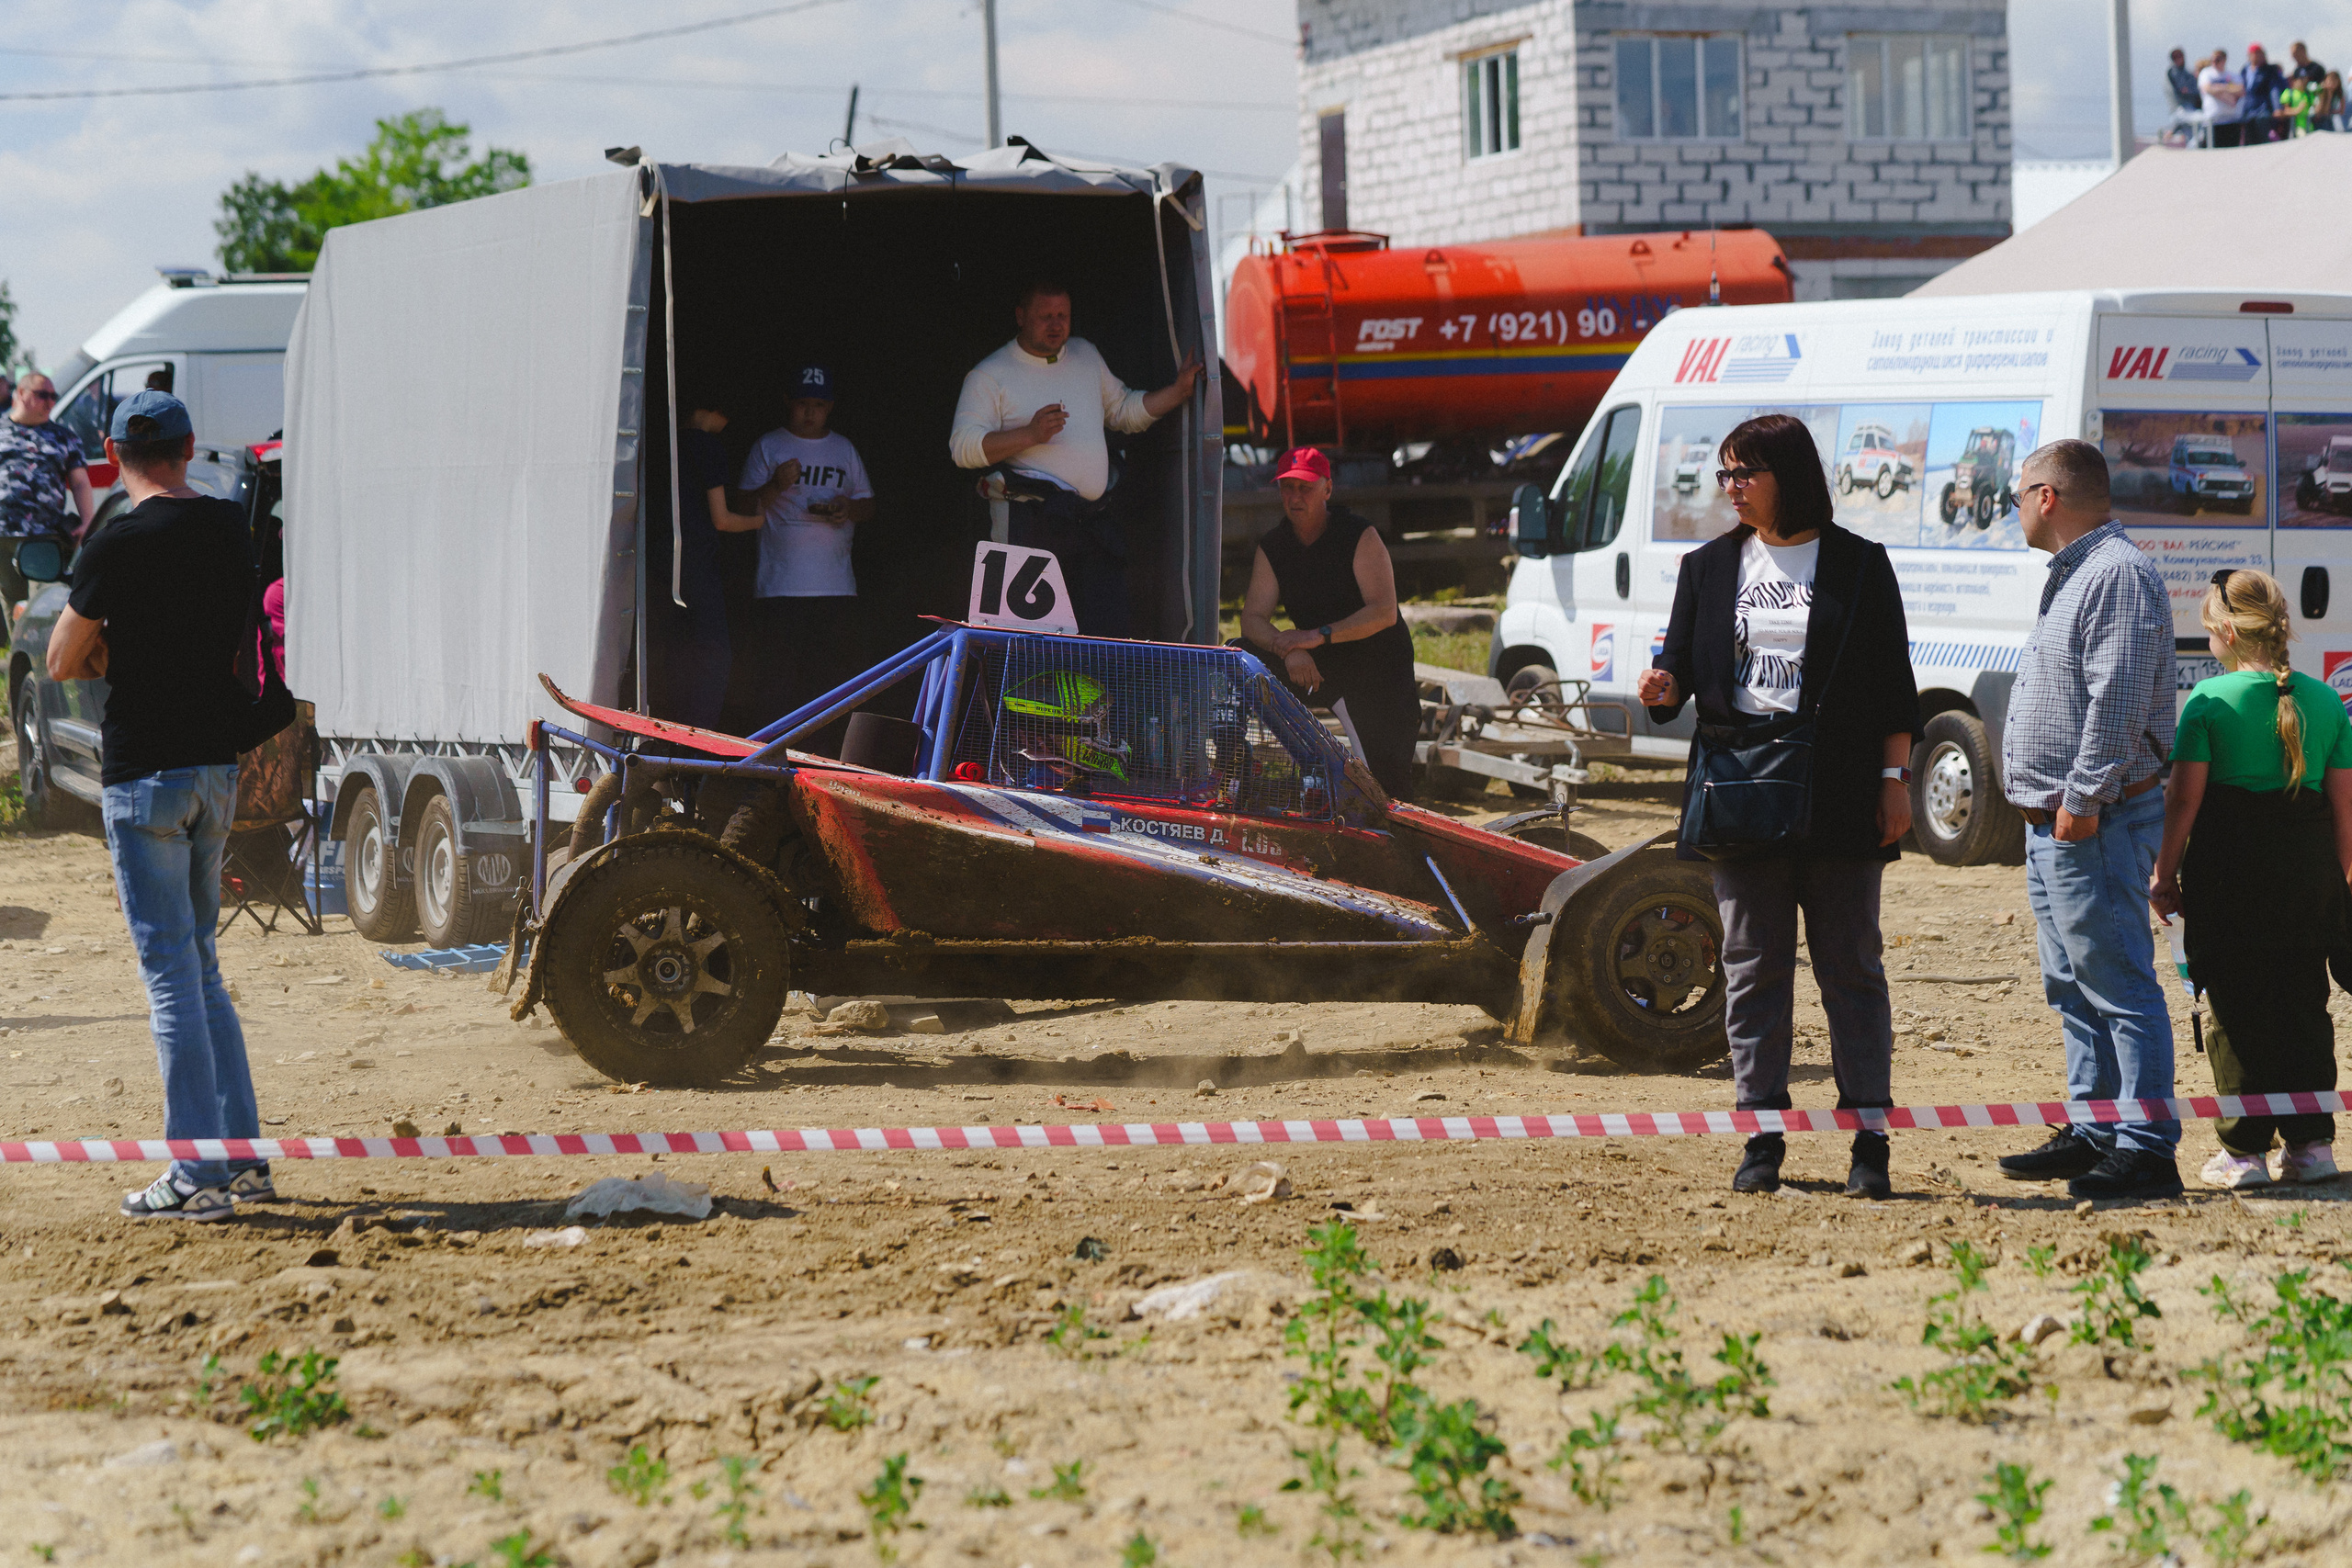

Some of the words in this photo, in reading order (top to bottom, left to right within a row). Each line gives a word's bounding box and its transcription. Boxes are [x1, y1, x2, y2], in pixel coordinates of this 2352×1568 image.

[1438, 313, 1477, 343] +7
[1488, 309, 1568, 346] (921)
[1674, 337, 1733, 383] VAL
[1735, 334, 1779, 359] racing
[2107, 345, 2170, 380] VAL
[2177, 344, 2229, 365] racing
[802, 367, 825, 386] 25
[795, 465, 846, 489] HIFT
[979, 549, 1056, 620] 16
[2333, 676, 2352, 689] LAD
[1121, 817, 1205, 840] КОСТЯЕВ
[1209, 828, 1229, 846] Д.
